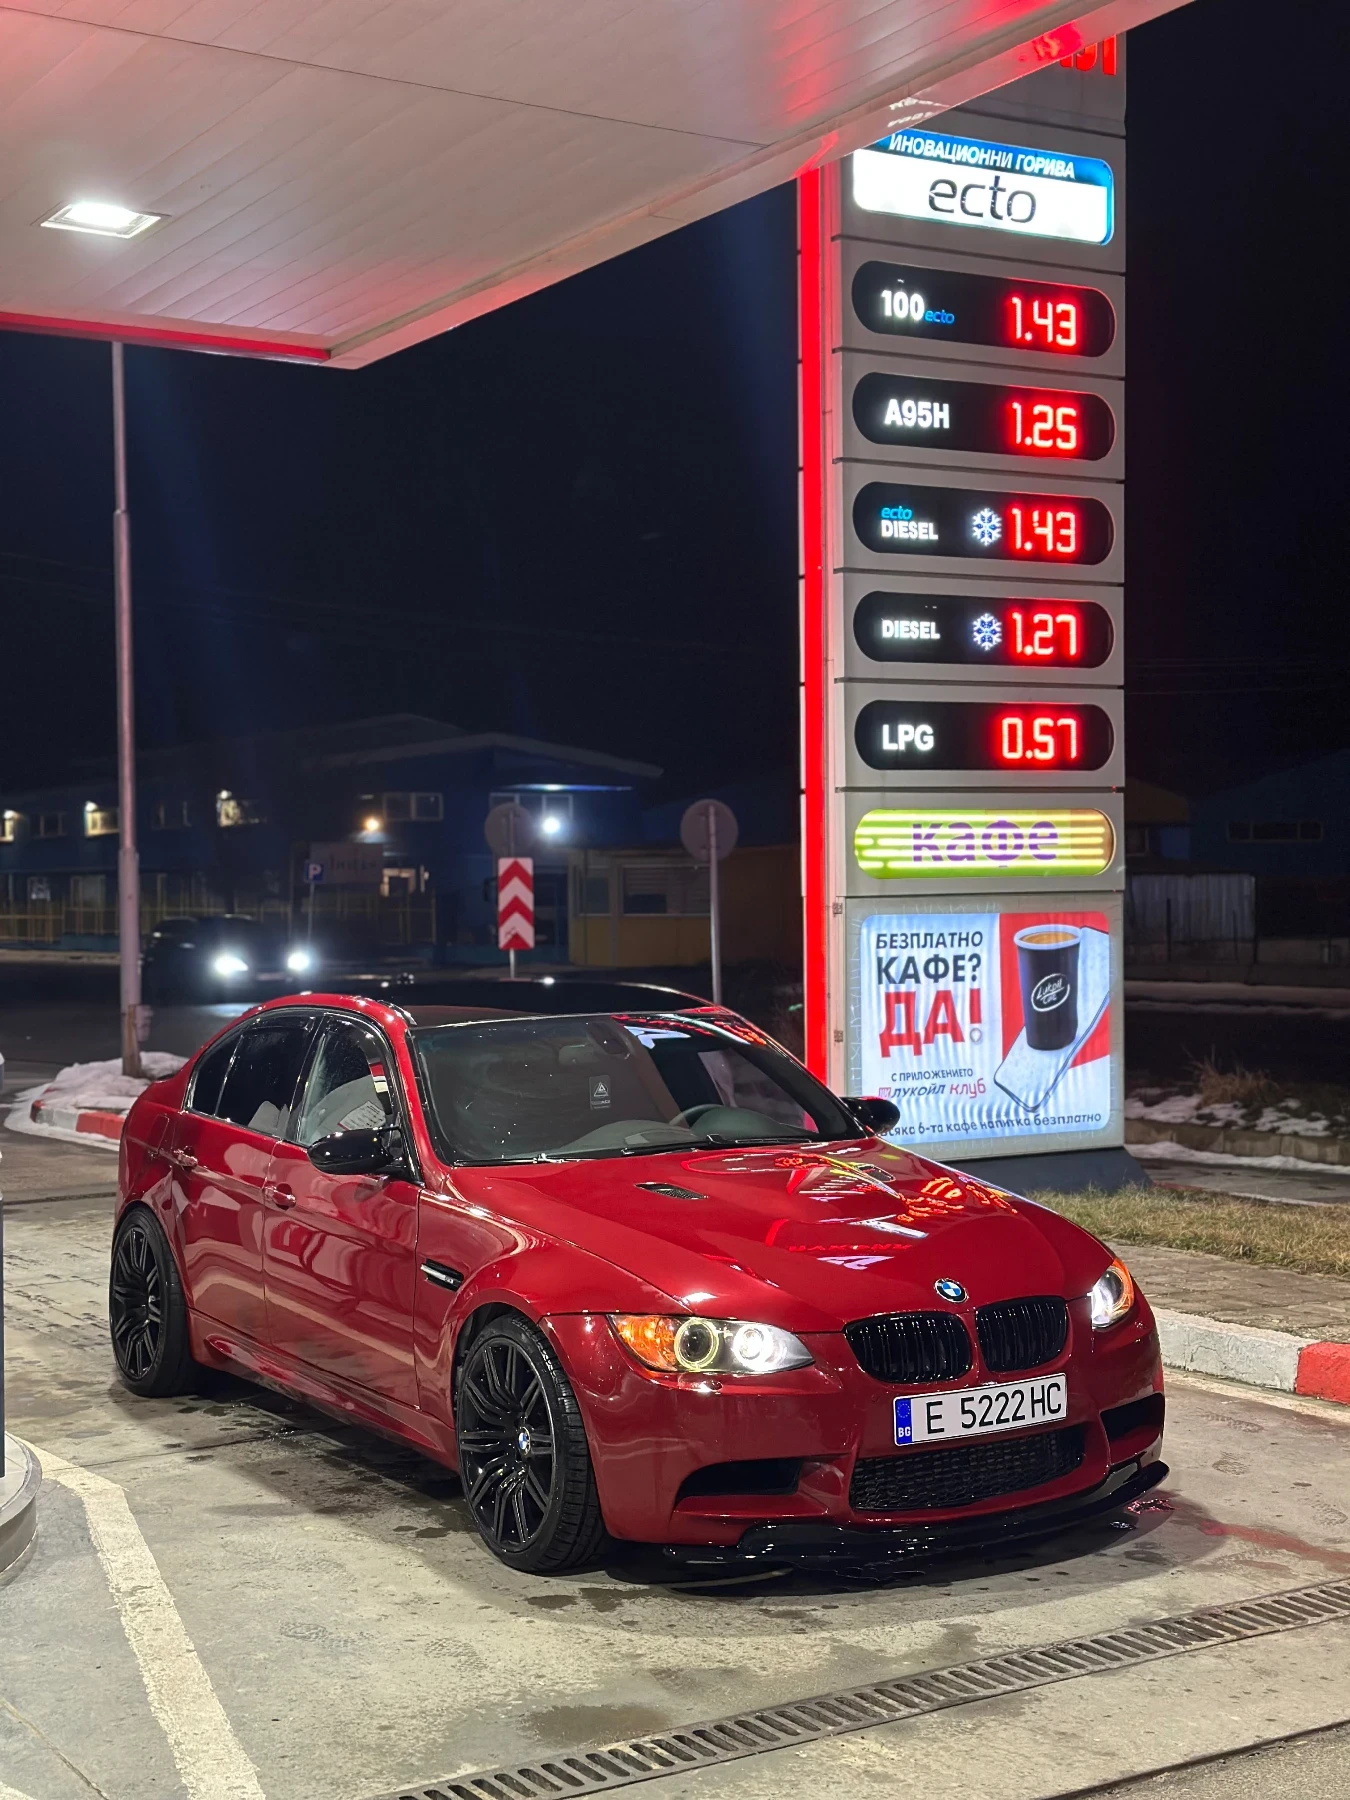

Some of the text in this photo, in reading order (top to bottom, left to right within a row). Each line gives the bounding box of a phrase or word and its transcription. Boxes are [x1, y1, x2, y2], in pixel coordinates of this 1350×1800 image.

[888, 133, 1076, 180] ИНОВАЦИОННИ ГОРИВА
[928, 175, 1037, 223] ecto
[881, 289, 955, 324] 100 ecto
[1011, 297, 1077, 346] 1.43
[1012, 402, 1077, 449] 1.25
[880, 505, 913, 520] ecto
[881, 520, 938, 540] DIESEL
[1011, 508, 1076, 553] 1.43
[881, 619, 940, 639] DIESEL
[1012, 612, 1077, 656] 1.27
[882, 724, 934, 750] LPG
[1002, 717, 1077, 760] 0.57
[308, 863, 322, 880] P
[876, 931, 983, 950] БЕЗПЛАТНО
[877, 953, 982, 985] КАФЕ?
[879, 988, 983, 1058] ДА!
[899, 1068, 974, 1081] ПРИЛОЖЕНИЕТО
[918, 1122, 943, 1134] 6-та
[946, 1119, 977, 1134] кафе
[979, 1117, 1031, 1131] напитка
[1033, 1113, 1101, 1126] безплатно
[926, 1382, 1062, 1435] E 5222 HC
[897, 1426, 912, 1438] BG
